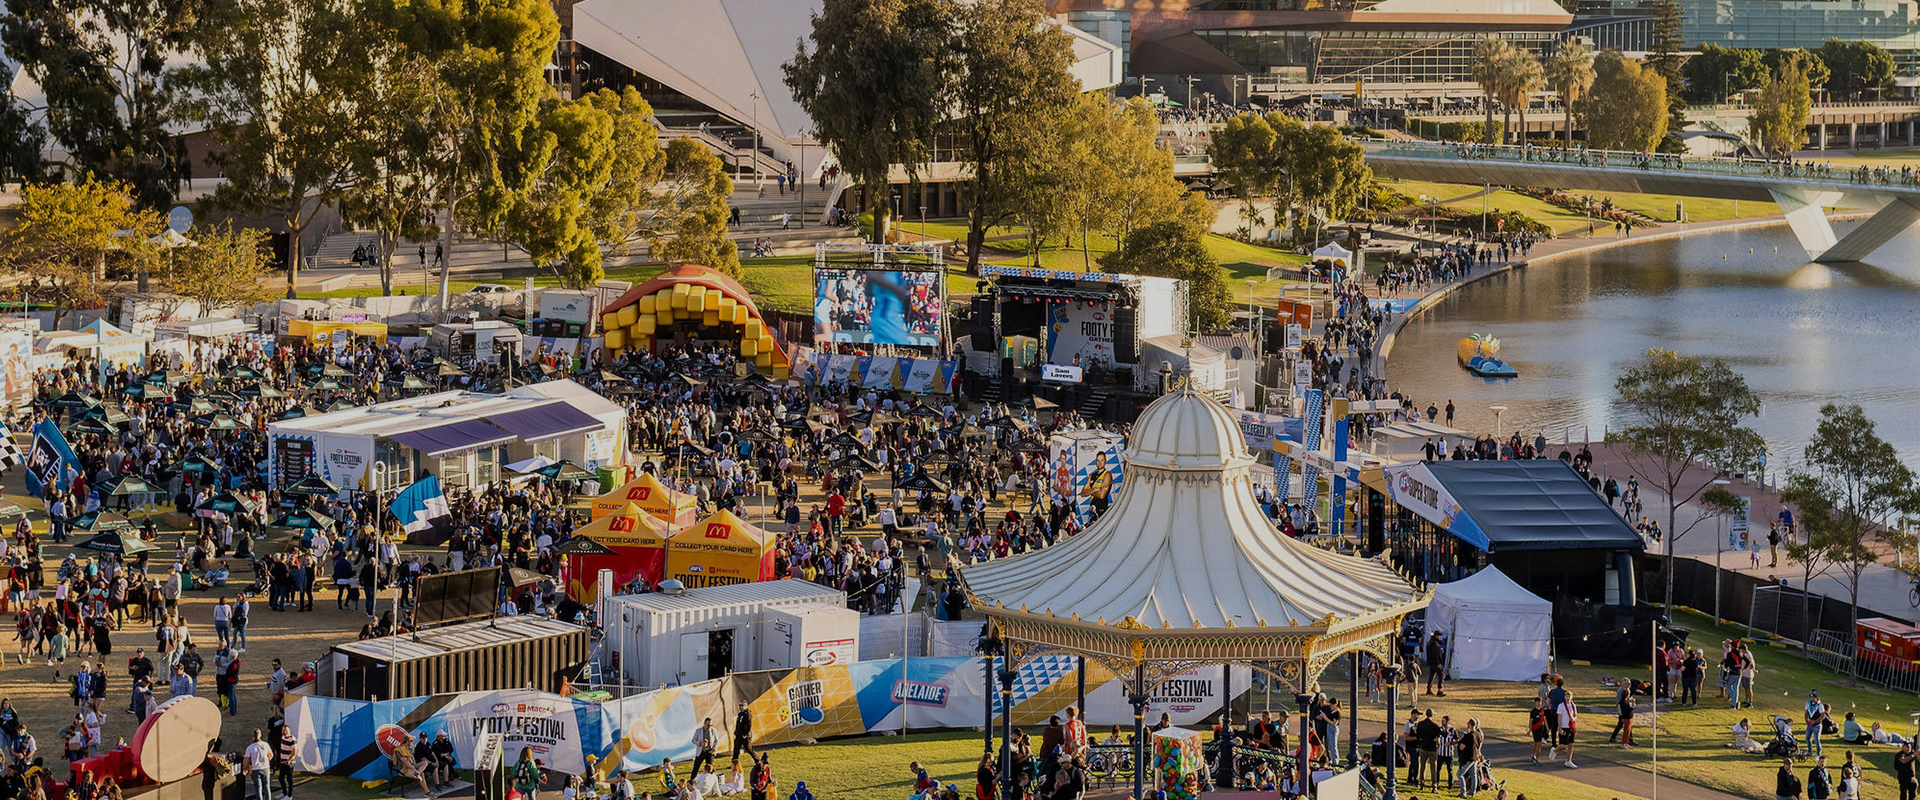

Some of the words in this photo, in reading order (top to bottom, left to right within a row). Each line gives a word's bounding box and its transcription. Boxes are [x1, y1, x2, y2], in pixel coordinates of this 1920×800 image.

[1081, 321, 1109, 336] FOOTY
[1409, 476, 1423, 502] SUPER
[1424, 484, 1439, 510] STORE
[788, 681, 822, 700] GATHER
[894, 682, 944, 701] ADELAIDE
[1162, 679, 1214, 697] FESTIVAL
[527, 705, 554, 714] Maccs
[790, 696, 820, 713] ROUND
[790, 711, 803, 726] IT!
[473, 716, 513, 737] FOOTY
[516, 716, 566, 741] FESTIVAL
[526, 736, 557, 746] ROUND
